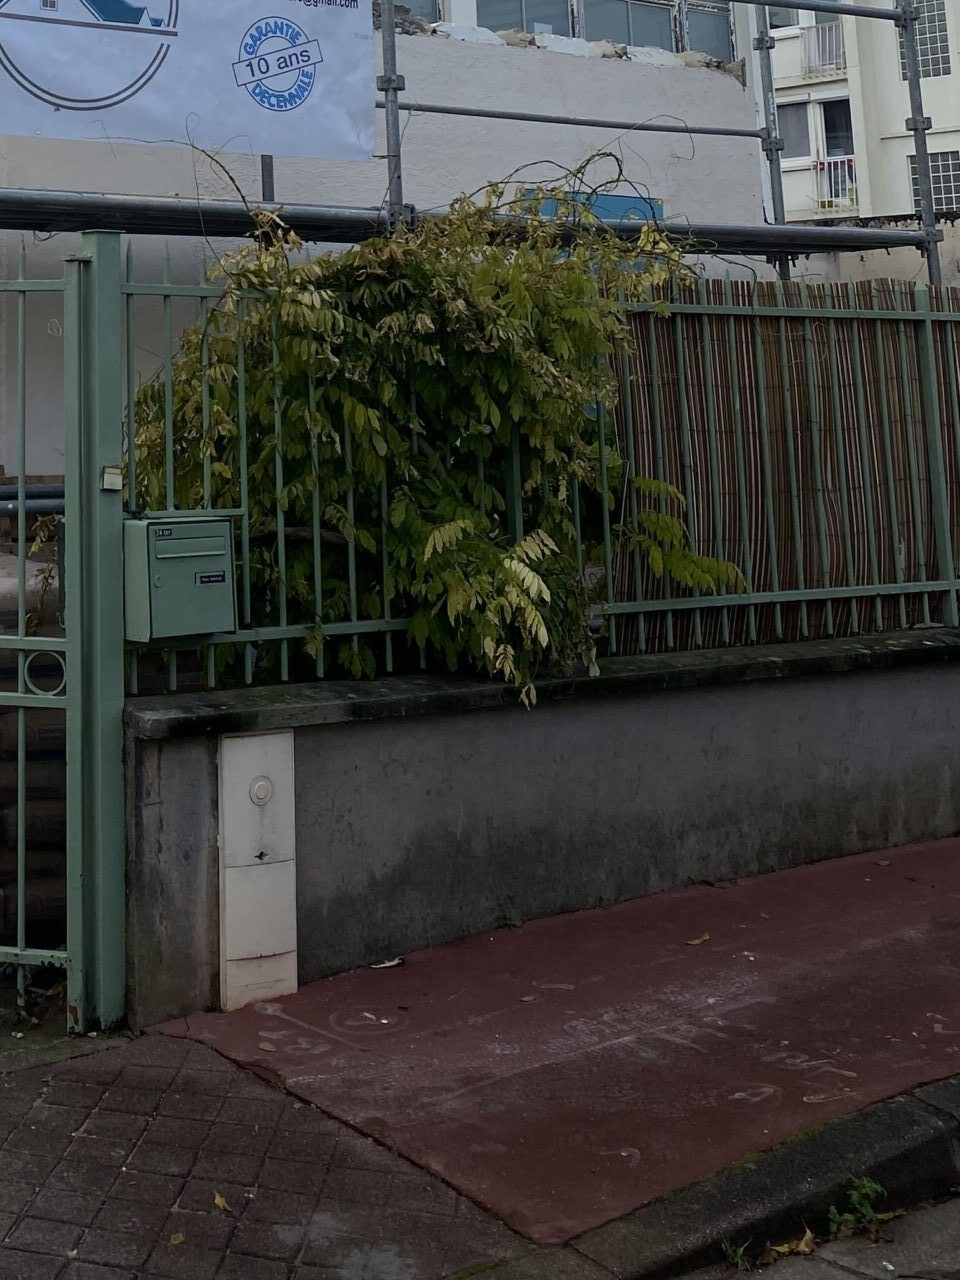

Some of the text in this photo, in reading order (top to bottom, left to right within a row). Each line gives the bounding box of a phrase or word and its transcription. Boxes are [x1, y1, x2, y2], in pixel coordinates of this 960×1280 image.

[244, 21, 302, 56] GARANTIE
[246, 49, 311, 78] 10 ans
[251, 69, 313, 109] DECENNALE
